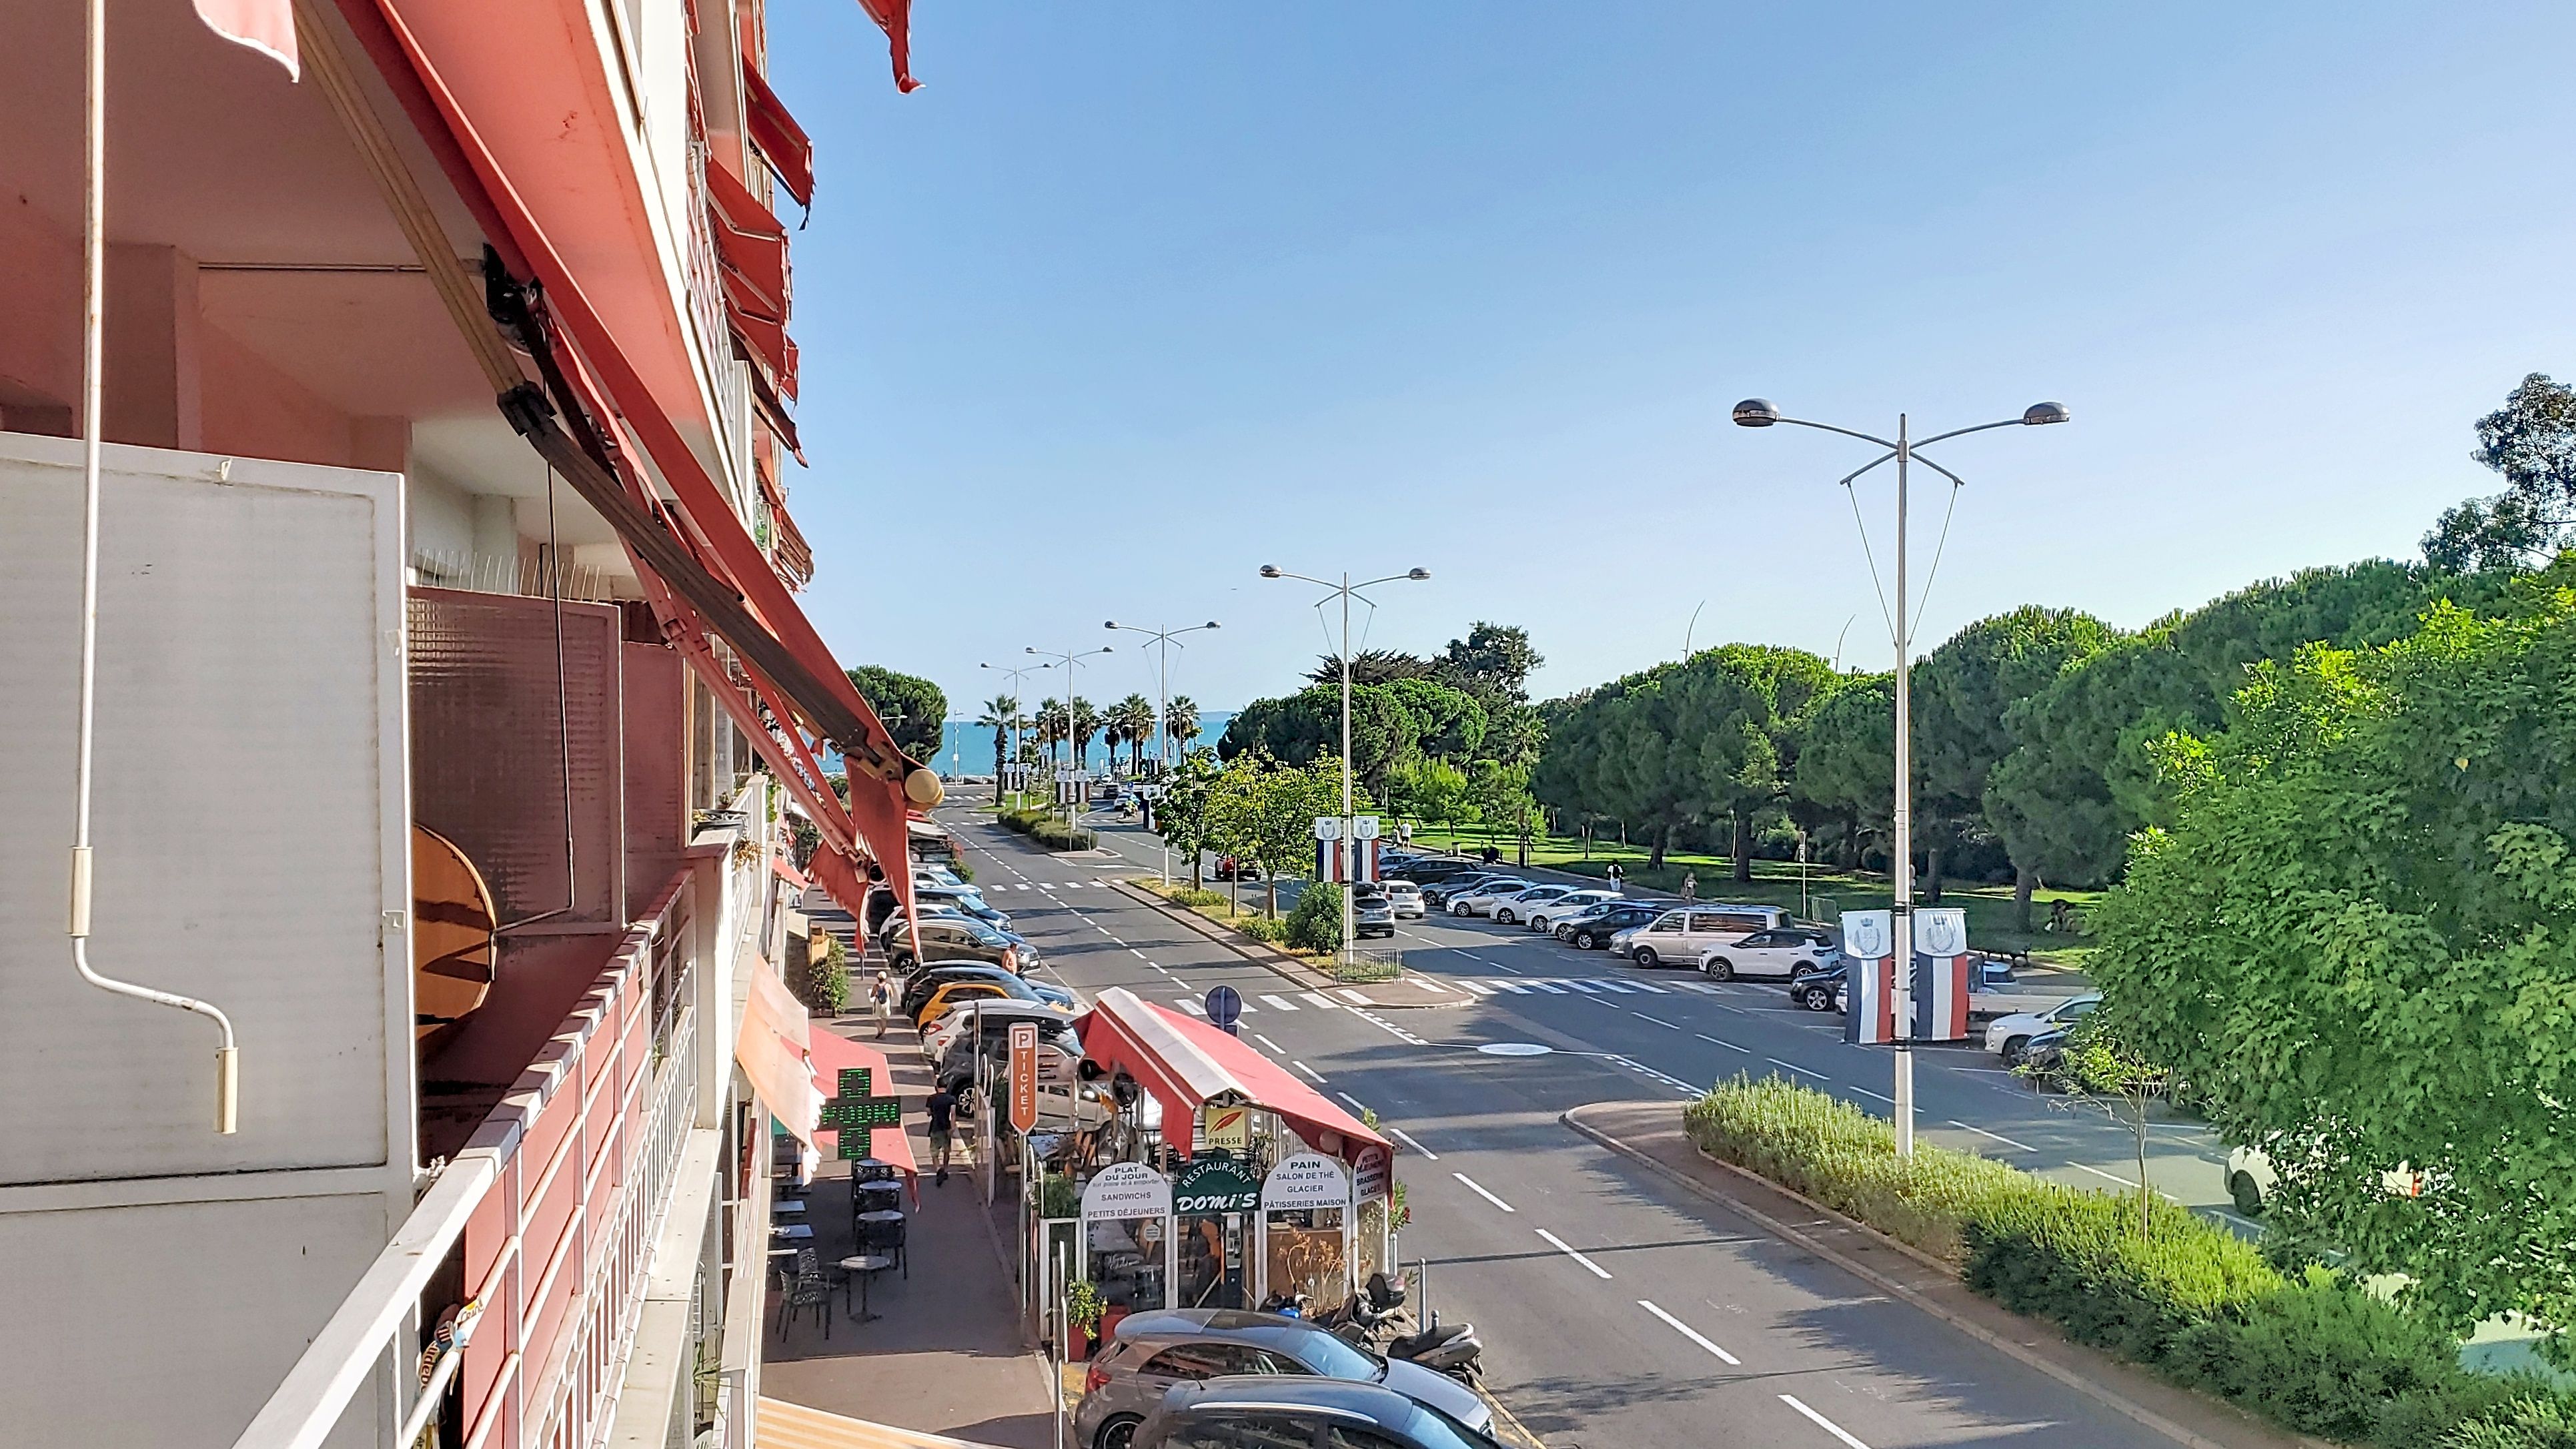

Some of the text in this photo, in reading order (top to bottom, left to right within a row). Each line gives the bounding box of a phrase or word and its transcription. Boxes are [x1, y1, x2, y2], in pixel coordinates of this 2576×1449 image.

[1019, 1033, 1029, 1047] P
[1020, 1051, 1029, 1115] TICKET
[1209, 1137, 1242, 1145] PRESSE
[1291, 1161, 1321, 1169] PAIN
[1182, 1161, 1251, 1188] RESTAURANT
[1287, 1185, 1324, 1193] GLACIER
[1101, 1191, 1151, 1201] SANDWICHS
[1264, 1199, 1346, 1209] PÂTISSERIES MAISON
[1088, 1207, 1165, 1218] PETITS DÉJEUNERS
